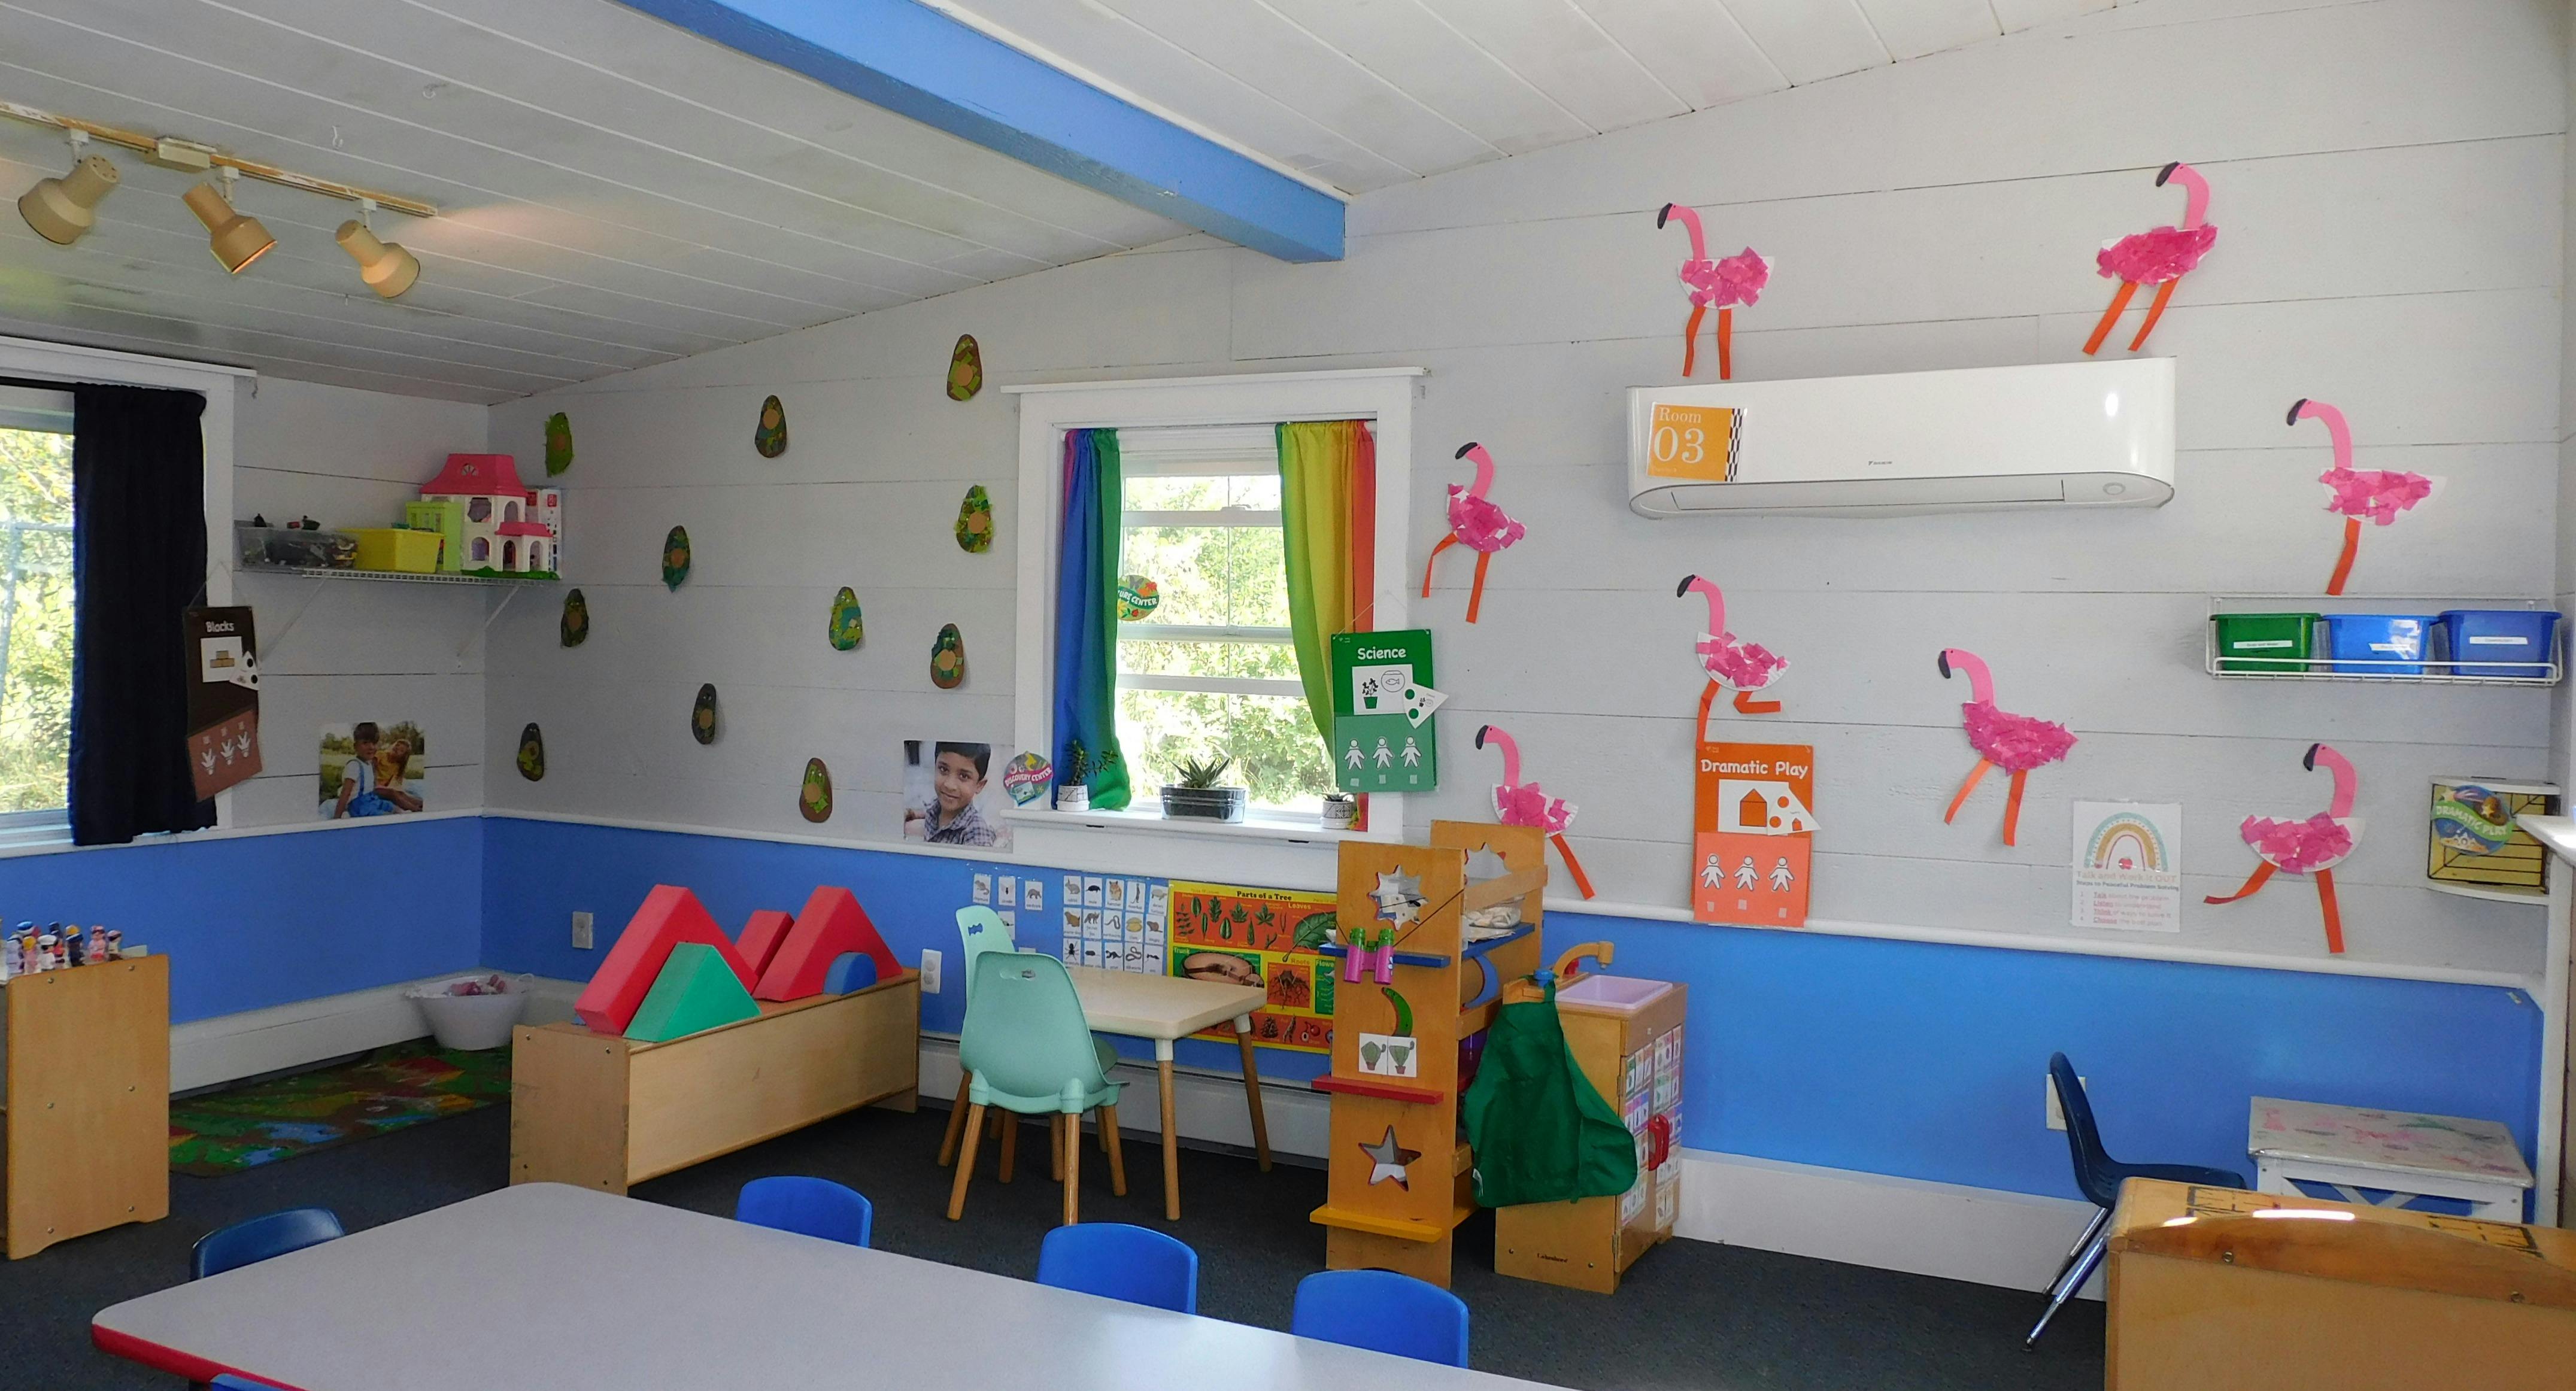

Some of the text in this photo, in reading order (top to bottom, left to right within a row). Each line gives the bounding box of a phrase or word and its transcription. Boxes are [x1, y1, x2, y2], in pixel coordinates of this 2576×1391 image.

[1659, 407, 1701, 424] Room
[1653, 426, 1705, 464] 03
[1118, 590, 1157, 606] URE CENTER
[205, 620, 235, 632] Blocks
[1357, 646, 1407, 660] Science
[1005, 767, 1052, 787] DISCOVERY CENTER
[1701, 759, 1809, 779] Dramatic Play
[2436, 805, 2507, 836] DRAMATIC PLAY
[1316, 958, 1334, 967] Flowe
